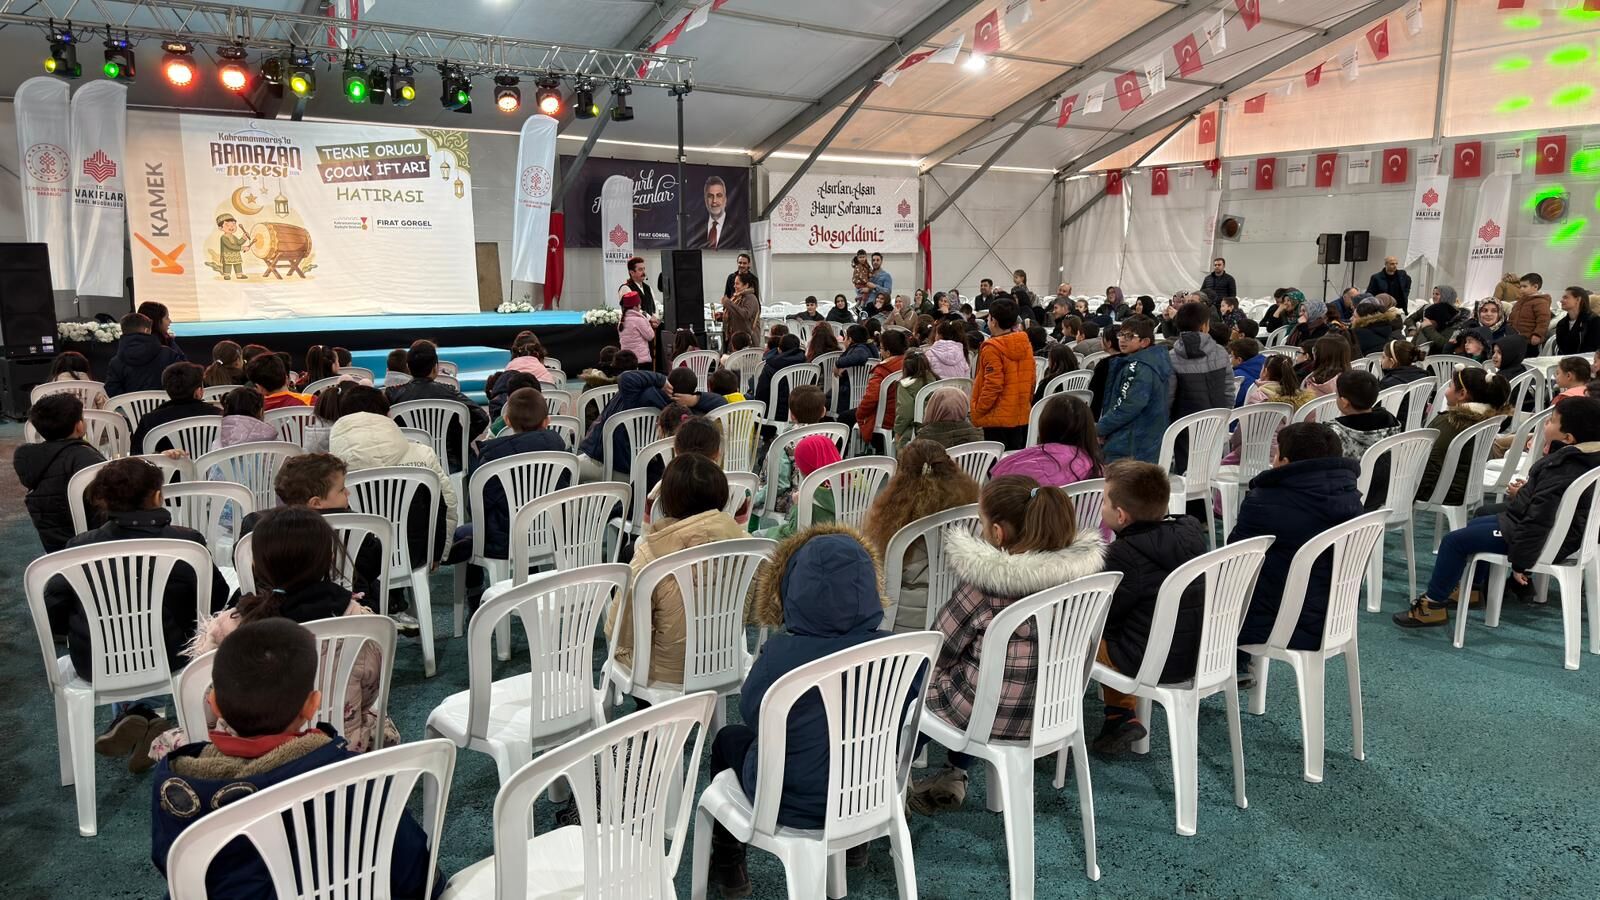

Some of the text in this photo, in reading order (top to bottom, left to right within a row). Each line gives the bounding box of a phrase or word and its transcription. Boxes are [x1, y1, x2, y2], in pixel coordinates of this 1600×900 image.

[210, 142, 302, 171] RAMAZAN
[322, 143, 421, 160] TEKNE ORUCU
[226, 163, 288, 180] neşesi
[324, 161, 427, 181] ÇOCUK İFTARI
[75, 189, 124, 202] VAKIFLAR
[145, 162, 169, 237] KAMEK
[337, 187, 424, 203] HATIRASI
[817, 181, 876, 200] Asırları Aşan
[810, 201, 882, 219] Hayır Soframıza
[401, 219, 432, 227] GÖRGEL
[809, 224, 885, 249] Hoşgeldiniz
